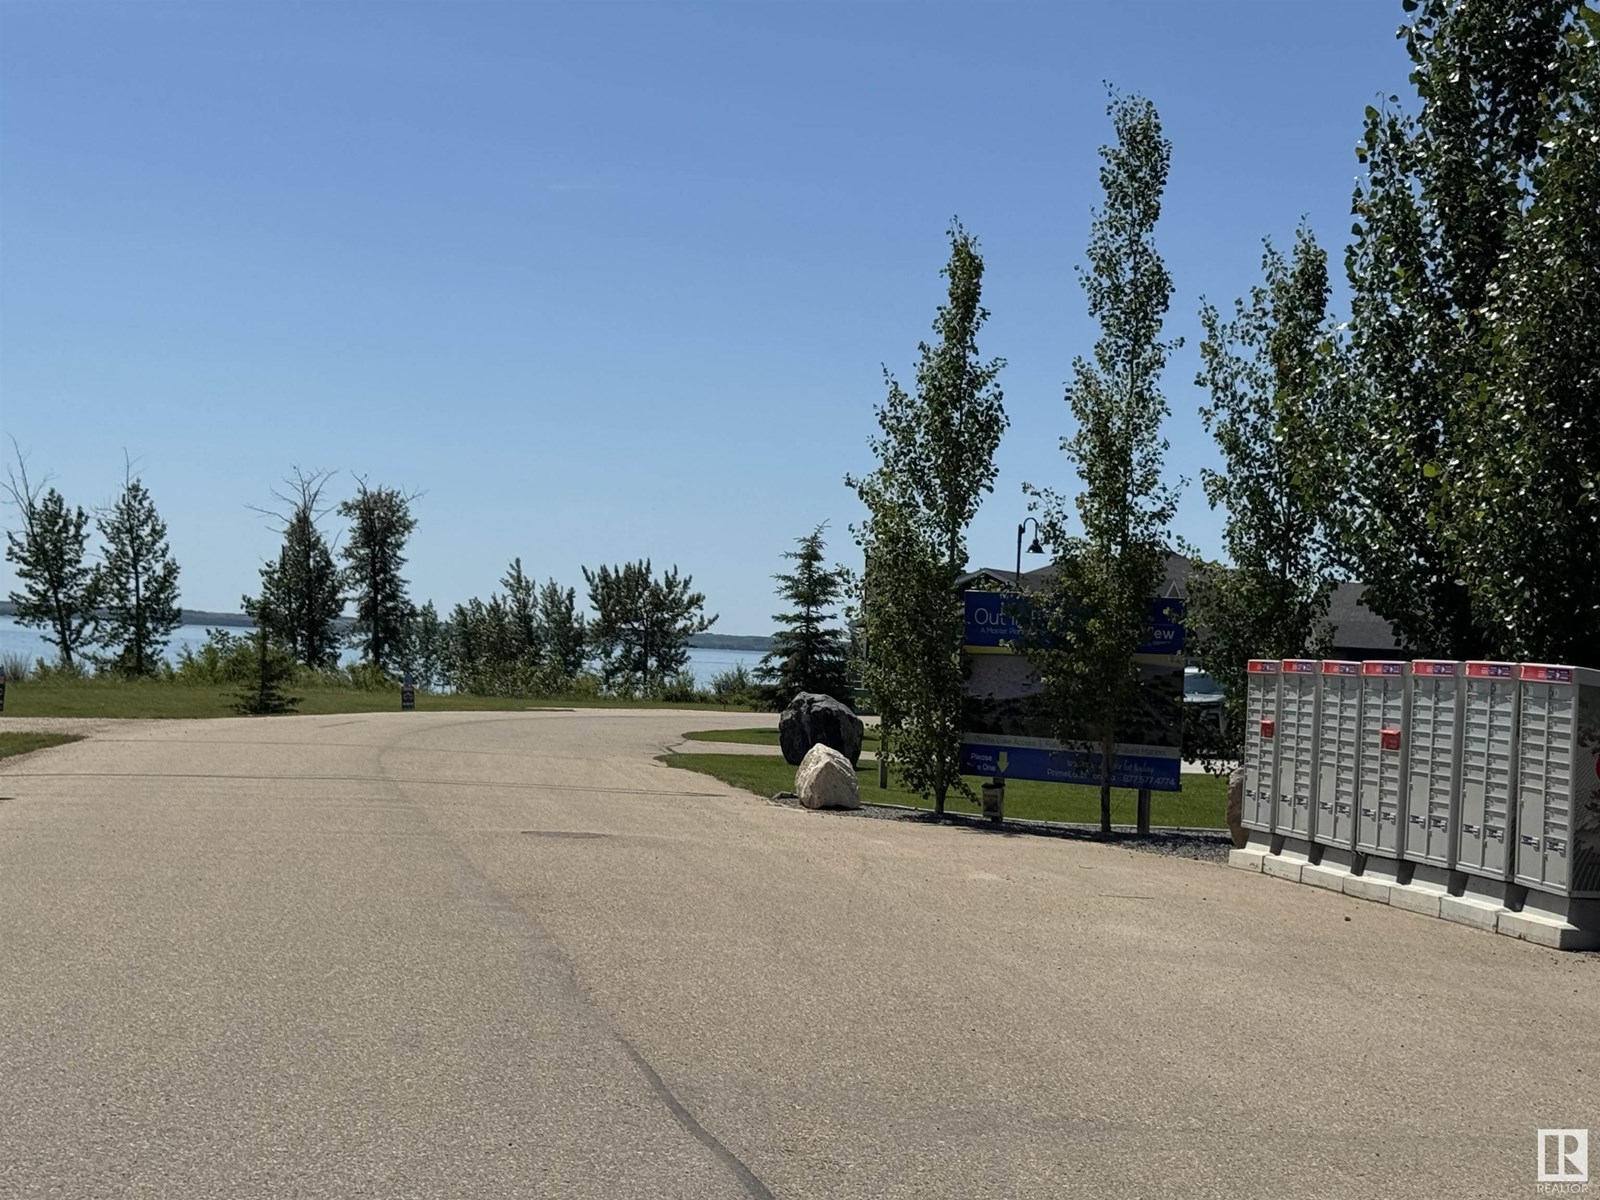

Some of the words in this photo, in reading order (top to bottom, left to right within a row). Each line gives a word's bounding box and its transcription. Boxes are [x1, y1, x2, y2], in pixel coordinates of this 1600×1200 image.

[974, 607, 1006, 626] Out
[970, 752, 992, 762] Please
[982, 762, 996, 772] One
